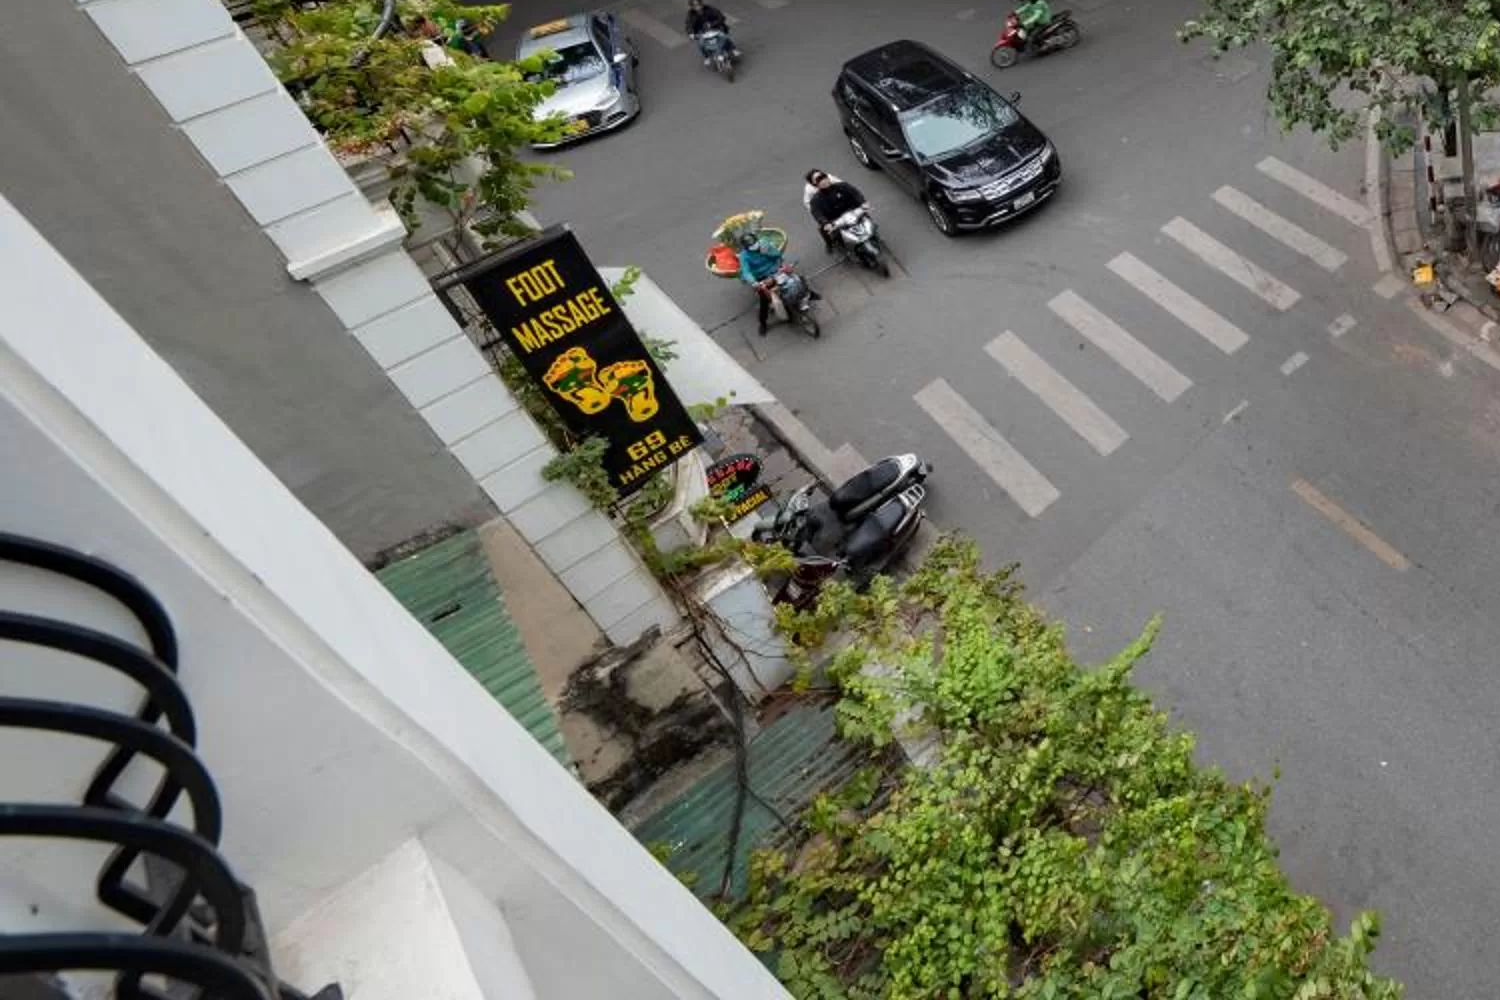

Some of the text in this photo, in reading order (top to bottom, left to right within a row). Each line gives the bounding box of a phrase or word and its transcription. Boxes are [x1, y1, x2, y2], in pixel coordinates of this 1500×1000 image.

[505, 259, 565, 307] FOOT
[511, 287, 612, 353] MASSAGE
[626, 429, 667, 461] 69
